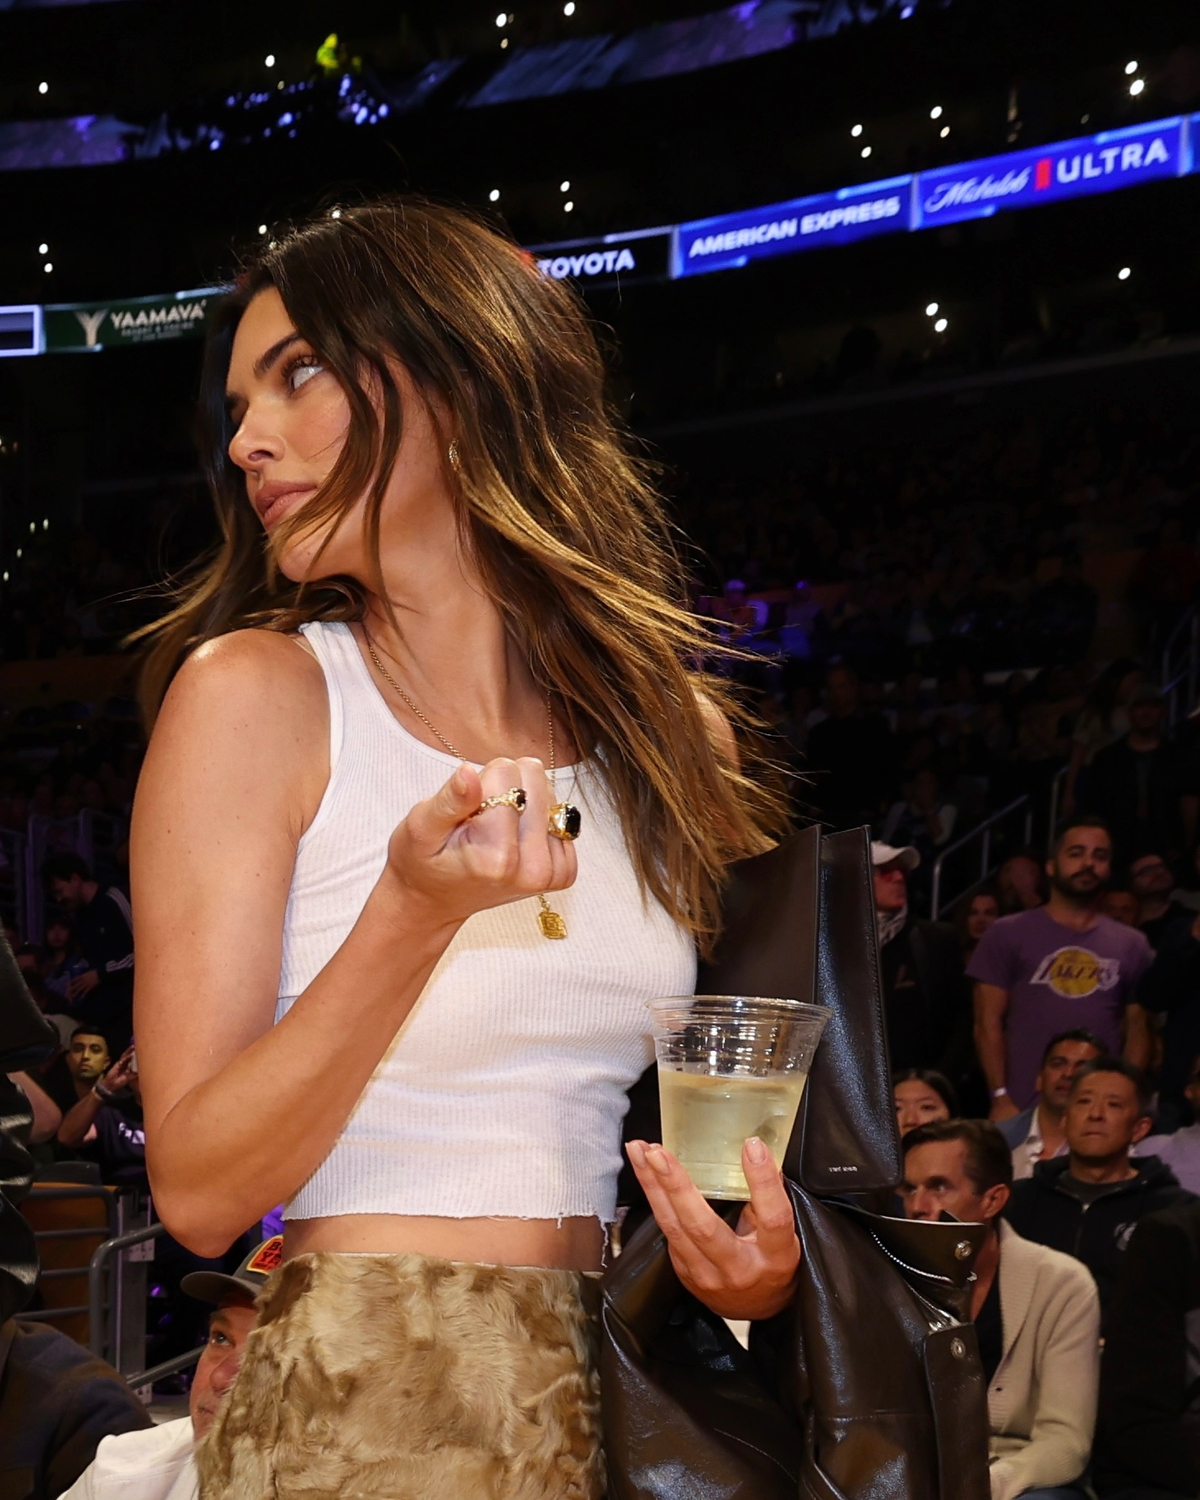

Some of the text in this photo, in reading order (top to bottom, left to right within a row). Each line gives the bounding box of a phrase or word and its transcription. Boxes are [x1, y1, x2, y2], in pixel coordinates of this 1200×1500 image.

[1056, 138, 1170, 183] ULTRA
[688, 196, 900, 257] AMERICAN EXPRESS
[536, 248, 636, 280] TOYOTA
